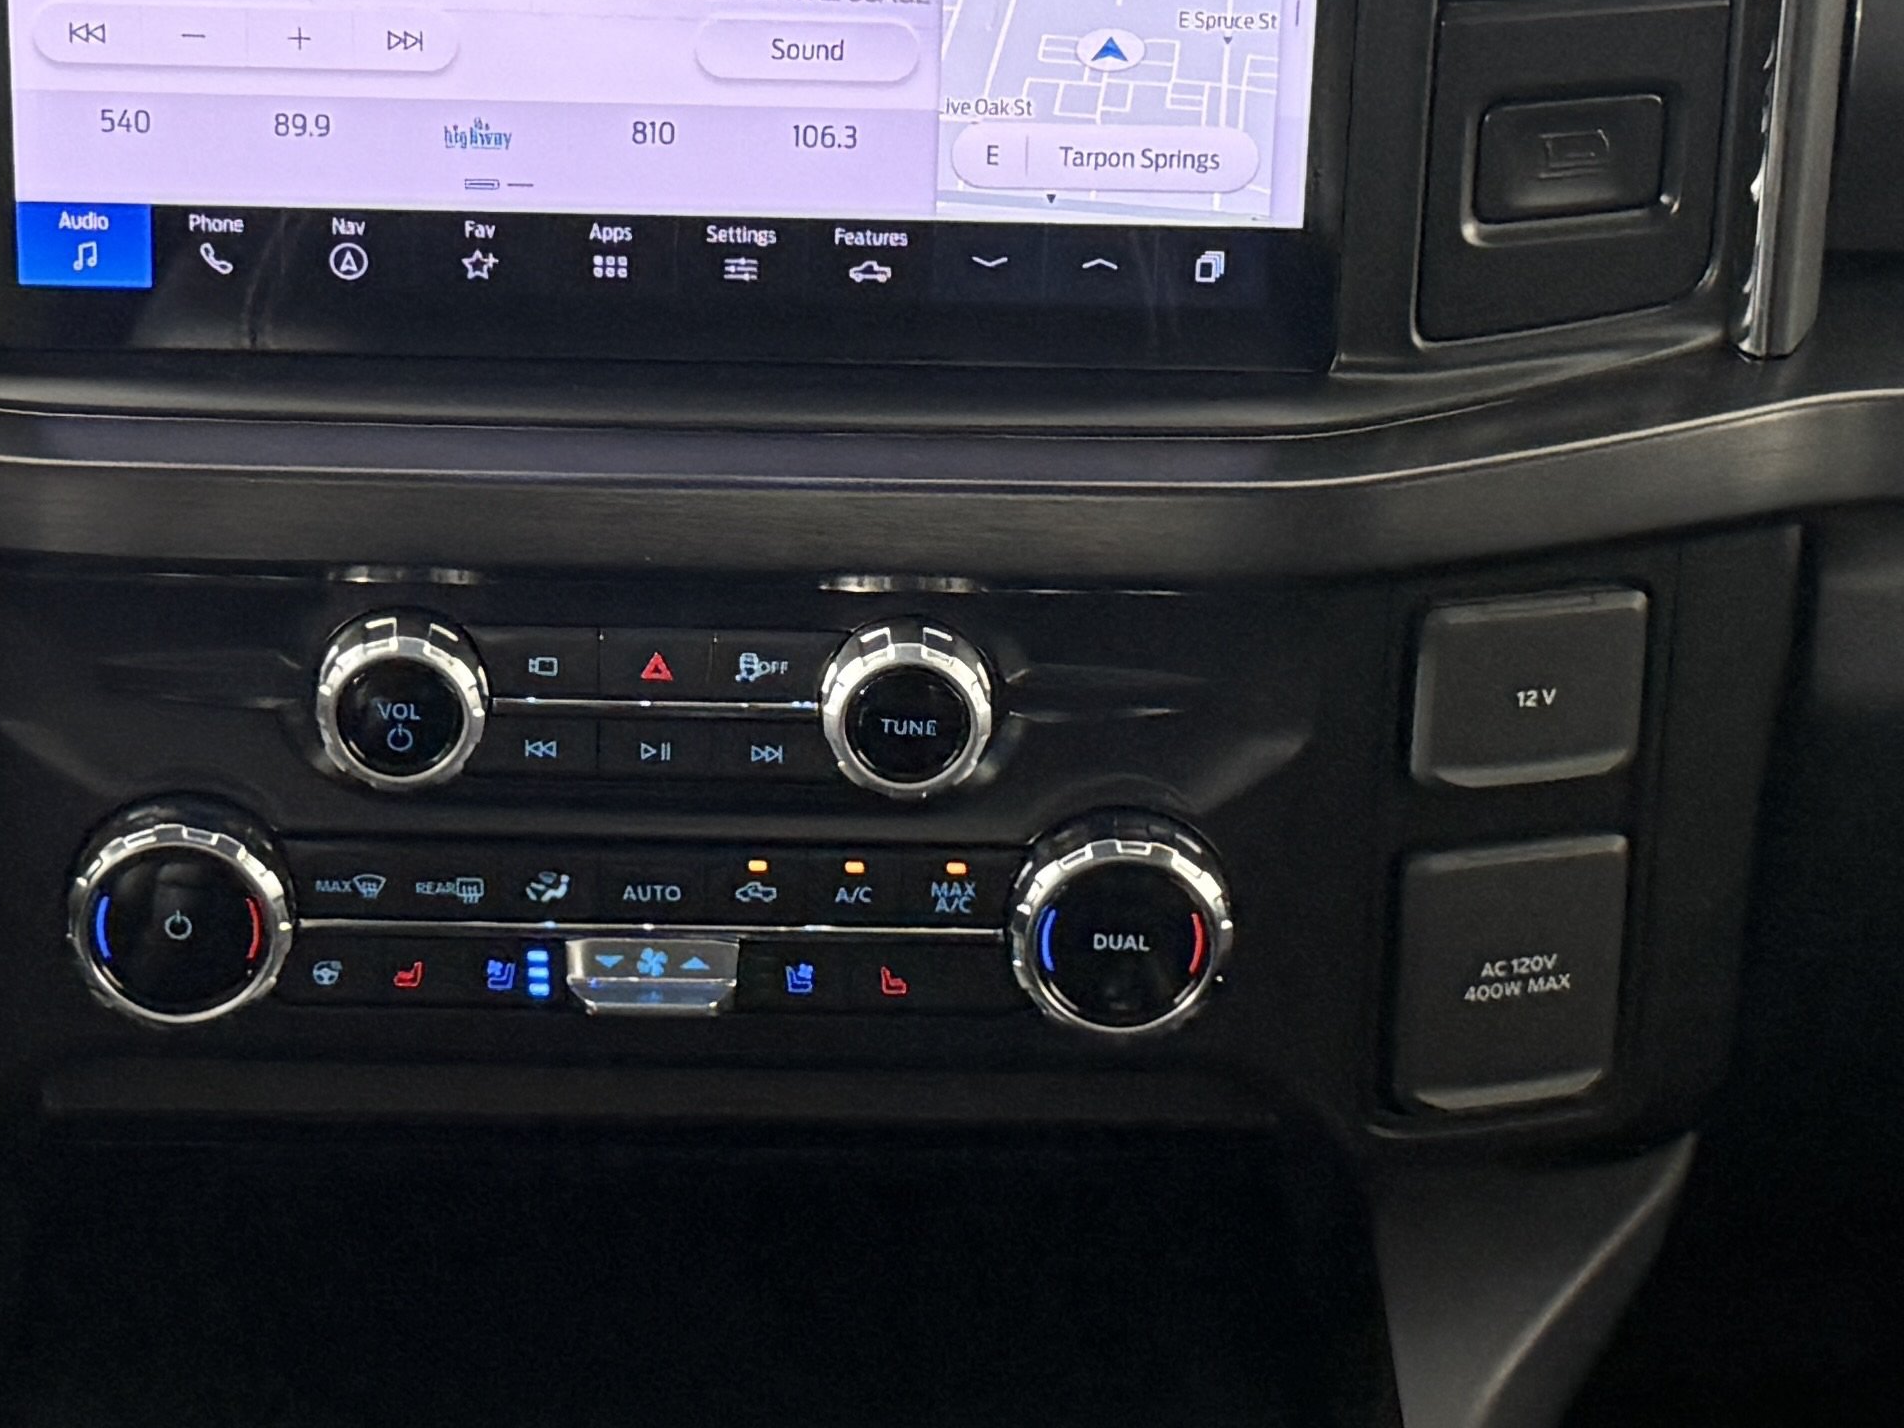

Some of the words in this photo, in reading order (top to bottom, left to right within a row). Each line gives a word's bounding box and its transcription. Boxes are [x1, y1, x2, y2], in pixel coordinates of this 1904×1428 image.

[1179, 11, 1190, 28] E
[1194, 11, 1255, 31] Spruce
[1259, 12, 1278, 30] St
[772, 38, 844, 61] Sound
[975, 98, 1009, 116] Oak
[1014, 98, 1032, 116] St
[100, 109, 151, 133] 540
[274, 112, 331, 138] 89.9
[631, 121, 676, 145] 810
[792, 124, 858, 149] 106.3
[987, 146, 999, 165] E
[1060, 147, 1134, 173] Tarpon
[1141, 148, 1220, 174] Springs
[59, 211, 109, 232] Audio
[189, 213, 244, 235] Phone
[331, 216, 366, 236] Nav
[464, 219, 495, 240] Fav
[589, 222, 633, 244] Apps
[706, 225, 777, 247] Settings
[834, 227, 908, 248] Features
[758, 660, 788, 676] OFF
[1516, 690, 1538, 708] 12
[1540, 688, 1558, 706] V
[377, 702, 421, 722] VOL
[881, 718, 938, 737] TUNE
[315, 880, 352, 894] MAX
[416, 881, 456, 896] REAR
[622, 883, 681, 902] AUTO
[835, 885, 872, 905] A/C
[931, 881, 976, 900] MAX
[934, 896, 972, 915] A/C
[1093, 933, 1150, 952] DUAL
[1480, 958, 1508, 978] AC
[1510, 953, 1558, 975] 120V
[1463, 979, 1522, 1002] 400W
[1527, 972, 1571, 995] MAX
